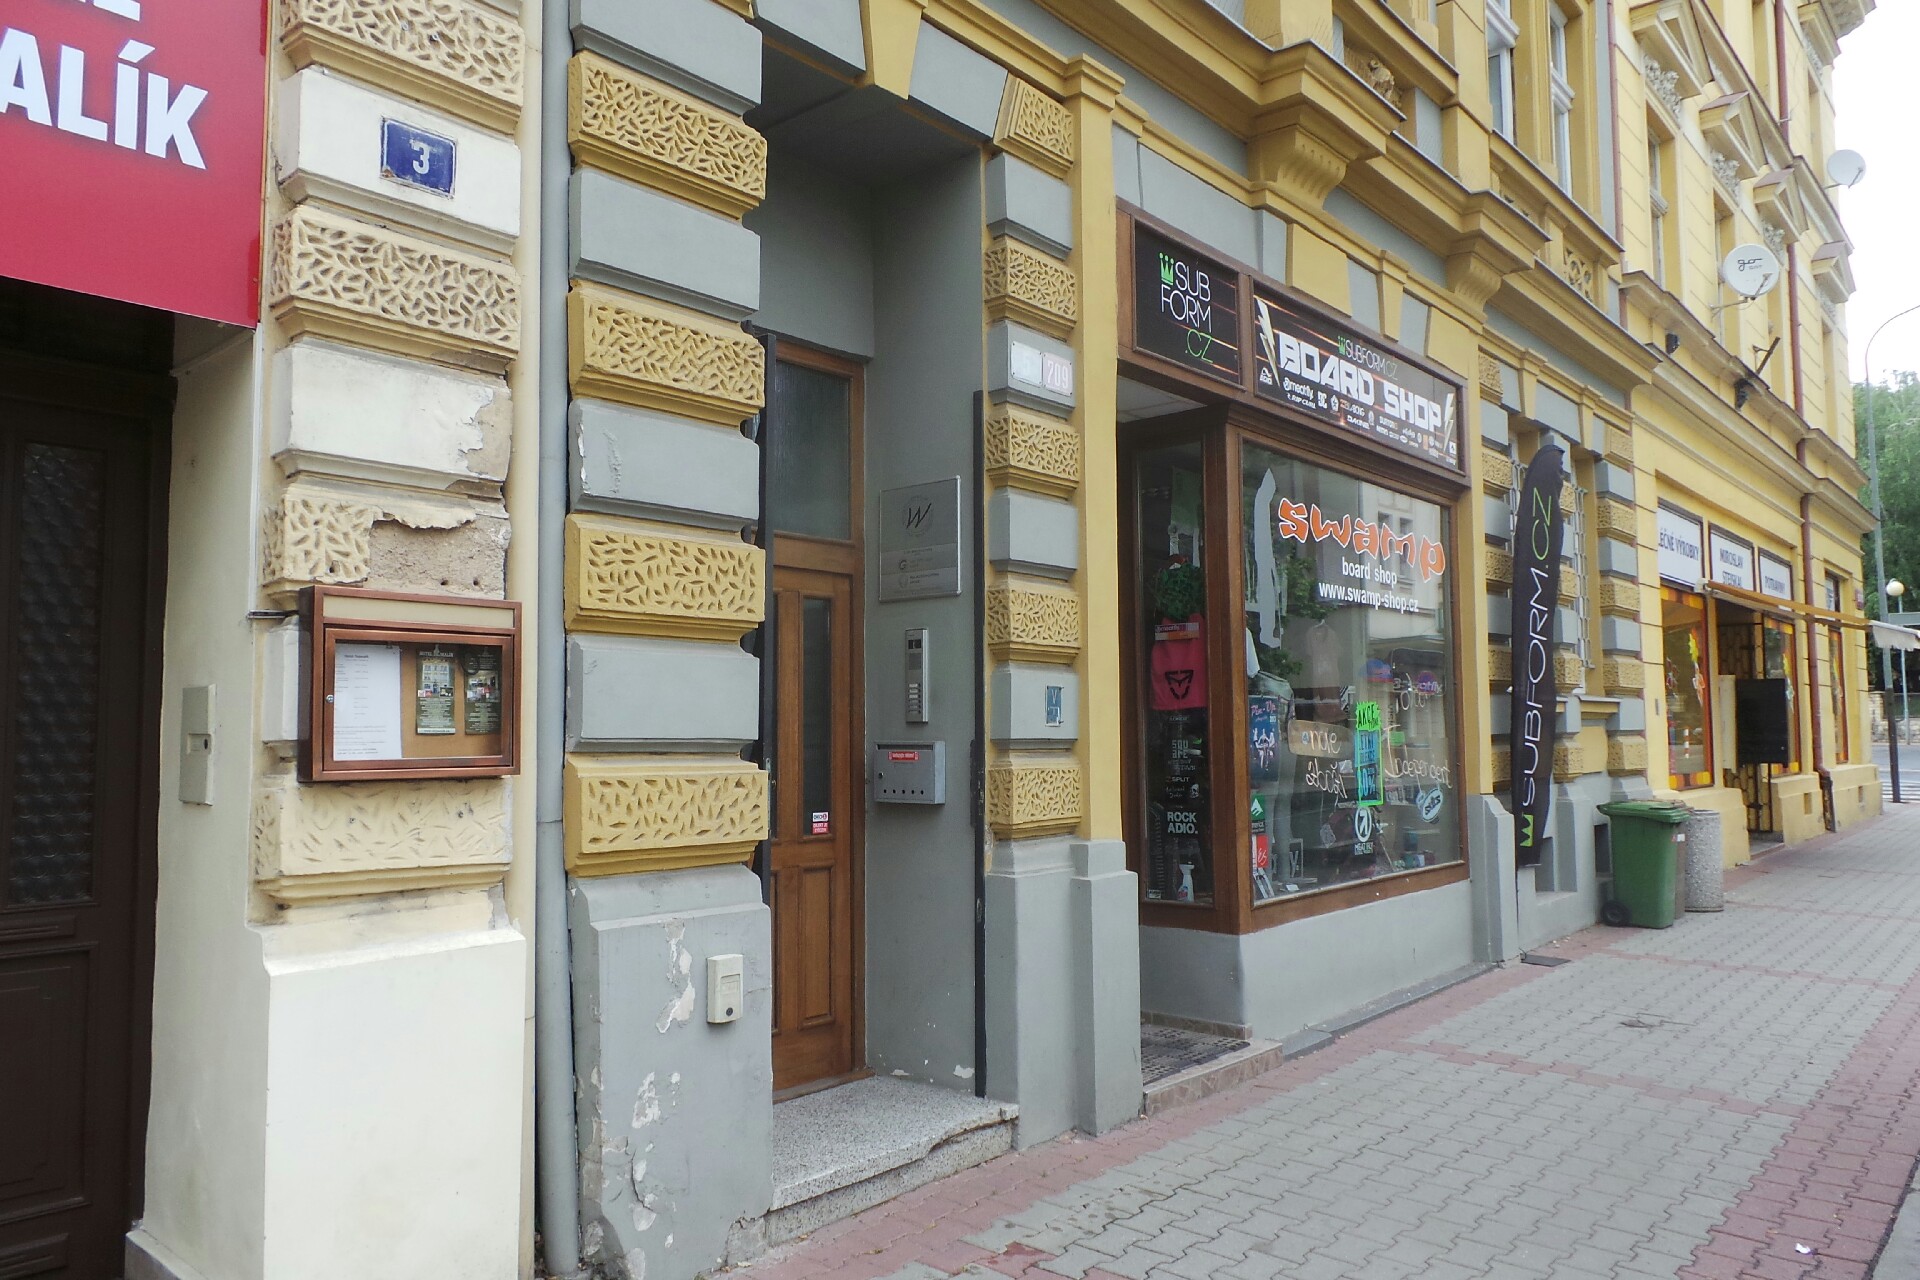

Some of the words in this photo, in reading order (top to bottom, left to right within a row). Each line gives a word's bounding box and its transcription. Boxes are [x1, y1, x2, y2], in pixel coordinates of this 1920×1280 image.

[408, 139, 431, 175] 3
[1174, 260, 1211, 301] SUB
[1161, 284, 1212, 333] FORM
[1047, 359, 1069, 390] 709
[1278, 333, 1375, 407] BOARD
[1383, 384, 1443, 433] SHOP
[1278, 497, 1446, 584] swamp
[1341, 556, 1371, 581] board
[1374, 565, 1398, 589] shop
[1318, 581, 1419, 614] www.swamp-shop.cz
[1522, 486, 1552, 808] SUBFORM.CZ
[1167, 811, 1198, 824] ROCK
[1167, 823, 1199, 835] ADIO.
